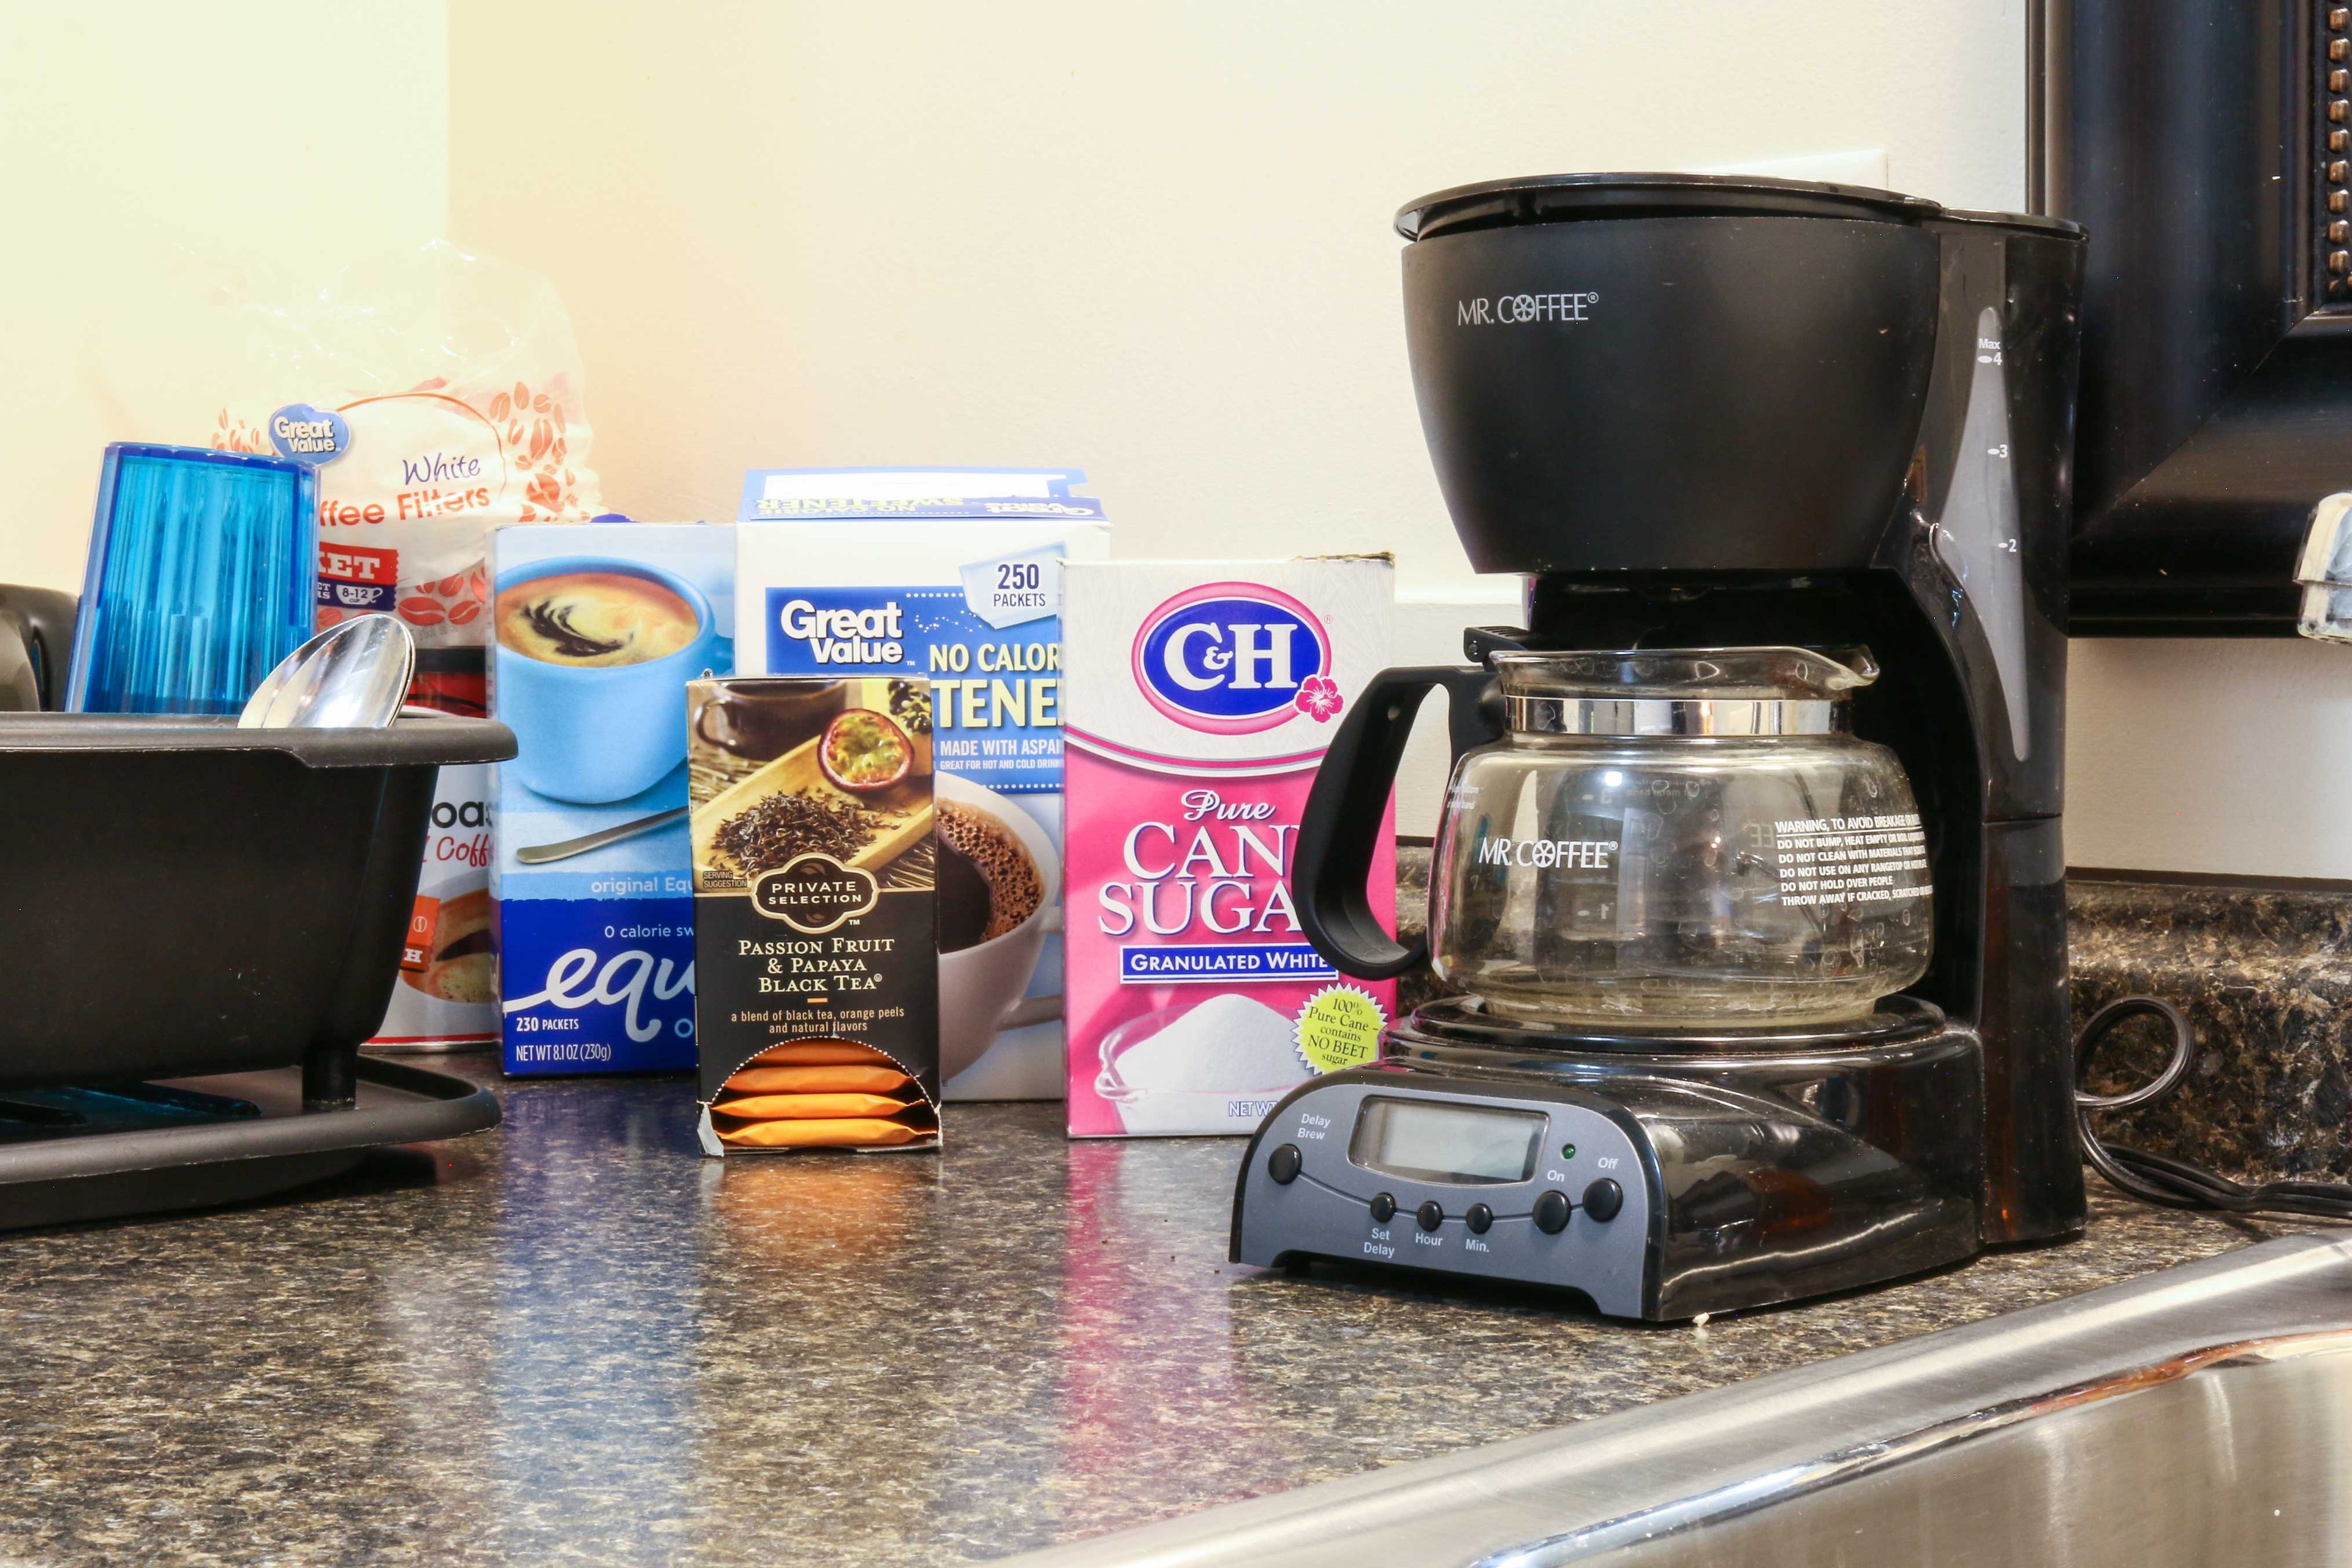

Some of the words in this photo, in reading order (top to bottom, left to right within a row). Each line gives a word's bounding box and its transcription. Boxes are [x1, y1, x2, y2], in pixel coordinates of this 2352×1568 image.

[1458, 299, 1494, 326] MR.
[1978, 338, 2000, 350] Max
[1992, 352, 2002, 366] 4
[274, 416, 336, 439] Great
[288, 437, 336, 453] Value
[1999, 444, 2008, 458] 3
[402, 452, 481, 486] White
[319, 500, 385, 527] ffee
[397, 487, 490, 521] Filters
[2008, 540, 2017, 552] 2
[997, 564, 1040, 590] 250
[342, 587, 368, 599] 8-12
[993, 593, 1046, 607] PACKETS
[780, 599, 905, 639] Great
[810, 635, 904, 664] Value
[1163, 621, 1298, 692] C&H
[929, 644, 970, 673] NO
[930, 678, 1063, 728] TENE
[940, 740, 979, 756] MADE
[982, 739, 1018, 756] WITH
[940, 760, 964, 771] GREAT
[966, 760, 981, 770] FOR
[982, 760, 997, 770] HOT
[998, 759, 1014, 769] AND
[1016, 758, 1036, 769] COLD
[1180, 789, 1276, 822] Pure
[429, 801, 492, 829] oa
[1774, 818, 1830, 834] WARNING,
[1830, 817, 1845, 831] TO
[1847, 816, 1874, 829] AVOID
[1874, 814, 1906, 828] BREAKAGE
[436, 833, 494, 867] Coff
[1123, 821, 1300, 878] CAN
[1777, 839, 1793, 850] DO
[1795, 838, 1814, 848] NOT
[1816, 836, 1843, 848] BUMP,
[1844, 835, 1864, 846] HEAT
[1865, 833, 1888, 845] EMPTY
[1888, 833, 1898, 843] OR
[1478, 836, 1513, 866] MR.
[1778, 854, 1794, 864] DO
[1796, 852, 1815, 863] NOT
[1817, 851, 1847, 862] CLEAN
[1847, 849, 1868, 860] WITH
[1868, 846, 1902, 858] MATERIALS
[703, 870, 734, 880] SERVING
[1779, 868, 1795, 878] DO
[1798, 867, 1817, 877] NOT
[1819, 865, 1837, 876] USE
[1838, 864, 1851, 875] ON
[1853, 863, 1870, 874] ANY
[1871, 861, 1904, 873] RANGETOP
[590, 876, 658, 895] original
[703, 879, 748, 888] SUGGESTION
[772, 881, 856, 894] PRIVATE
[1781, 882, 1796, 892] DO
[1798, 881, 1818, 891] NOT
[1820, 879, 1844, 890] HOLD
[1845, 877, 1868, 889] OVER
[1868, 875, 1893, 888] PEOPLE
[768, 894, 862, 905] SELECTION
[1782, 894, 1817, 907] THROW
[1819, 892, 1845, 905] AWAY
[1847, 892, 1855, 902] IF
[1856, 889, 1891, 902] CRACKED,
[1098, 880, 1303, 935] SUGA
[604, 925, 615, 938] 0
[620, 924, 671, 938] calorie
[676, 927, 694, 937] sw
[737, 939, 824, 956] PASSION
[831, 937, 895, 954] FRUIT
[767, 957, 783, 974] &
[791, 957, 868, 973] PAPAYA
[1129, 952, 1261, 971] GRANULATED
[1265, 951, 1329, 970] WHITE
[758, 976, 829, 993] BLACK
[502, 948, 695, 1042] equ
[731, 1014, 737, 1022] a
[741, 1011, 769, 1022] blend
[772, 1011, 783, 1021] of
[786, 1009, 813, 1020] black
[816, 1009, 837, 1021] tea,
[840, 1009, 875, 1020] orange
[878, 1006, 905, 1019] peels
[1332, 998, 1363, 1016] 100%
[516, 1017, 539, 1032] 230
[542, 1019, 579, 1031] PACKETS
[769, 1023, 788, 1034] and
[791, 1022, 829, 1033] natural
[832, 1020, 868, 1032] flavors
[1308, 1006, 1337, 1024] Pure
[1340, 1014, 1370, 1032] Cane
[1320, 1026, 1362, 1042] contains
[516, 1045, 533, 1062] NET
[534, 1045, 552, 1061] WT
[552, 1044, 565, 1061] 8.1
[565, 1044, 579, 1060] OZ
[579, 1043, 611, 1062] (230g)
[1307, 1033, 1330, 1050] NO
[1332, 1039, 1369, 1059] BEET
[1321, 1052, 1349, 1066] sugar
[1228, 1101, 1254, 1117] NET
[1300, 1114, 1331, 1129] Delay
[1297, 1127, 1325, 1140] Brew
[1598, 1156, 1618, 1170] Off
[1547, 1169, 1565, 1183] On
[1371, 1227, 1390, 1241] Set
[1415, 1232, 1444, 1247] Hour
[1363, 1242, 1395, 1258] Delay
[1465, 1238, 1490, 1253] Min.
